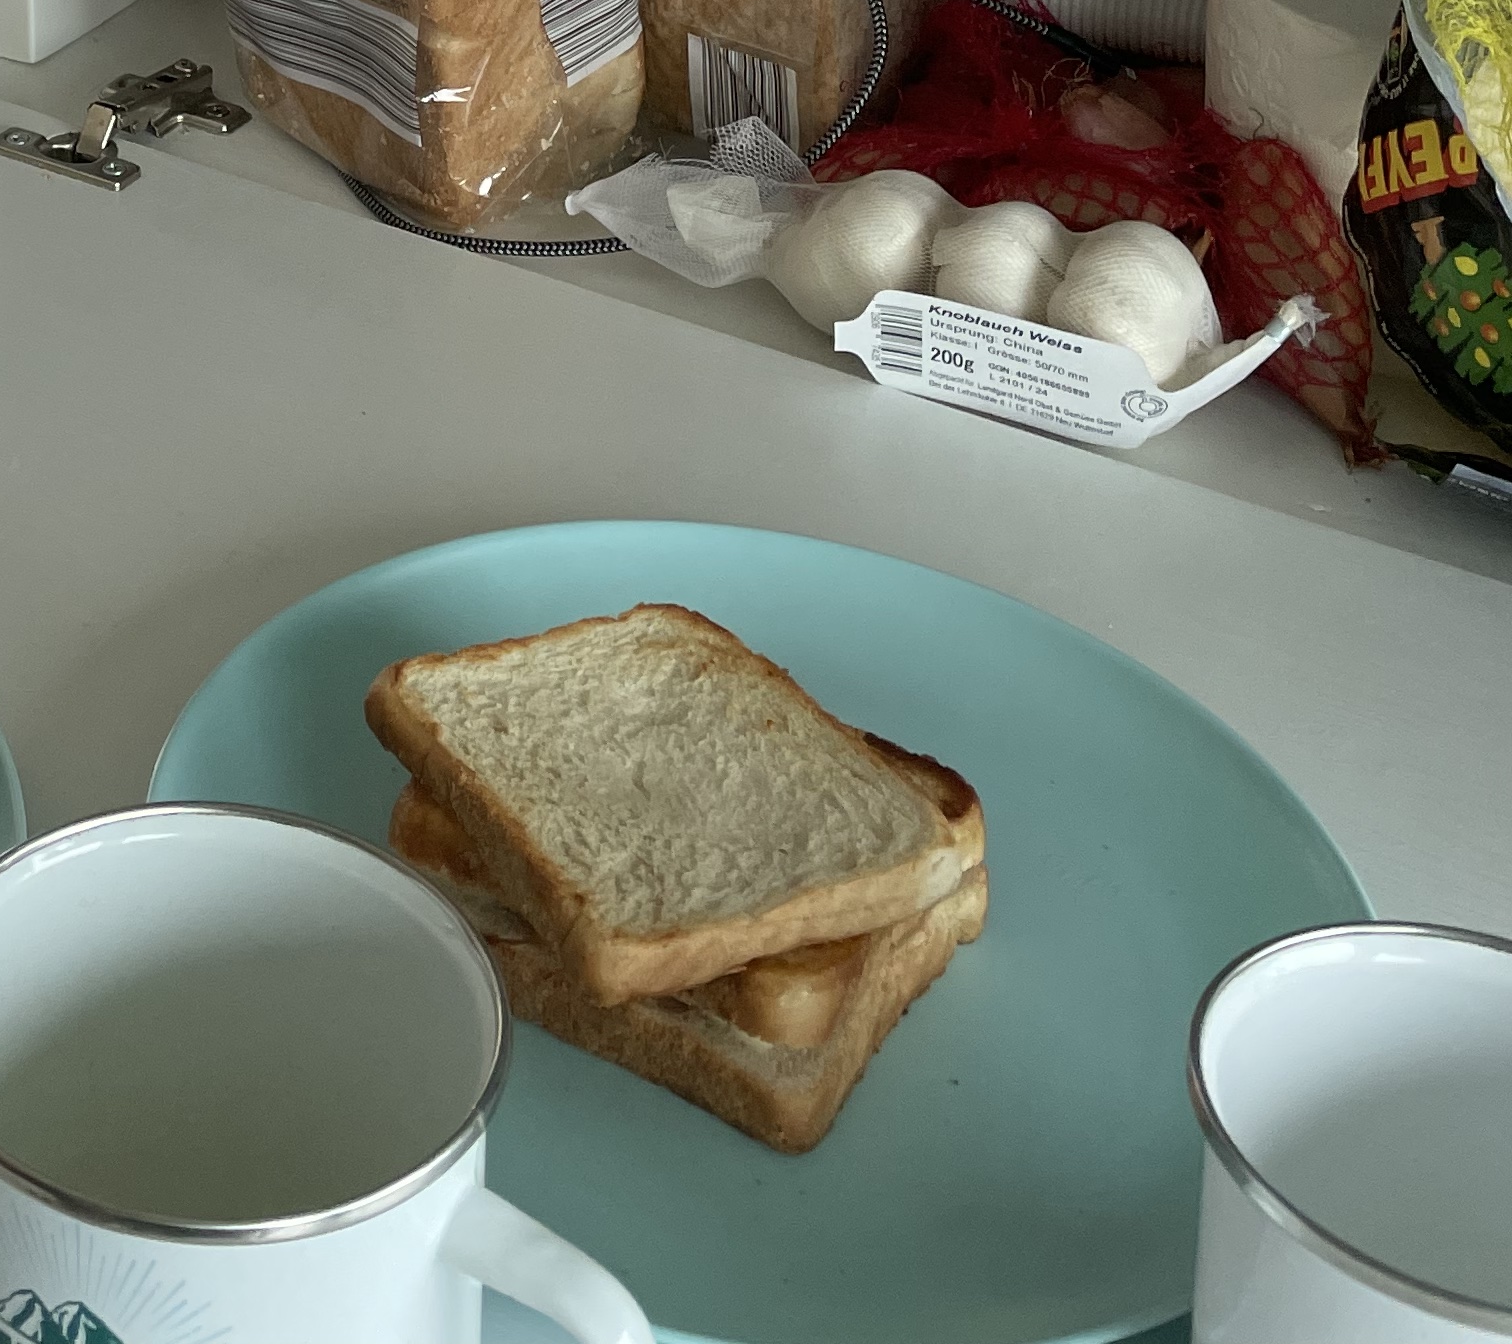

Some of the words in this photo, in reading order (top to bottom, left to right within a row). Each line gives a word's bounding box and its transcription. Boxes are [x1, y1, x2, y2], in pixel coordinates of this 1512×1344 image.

[928, 305, 1024, 337] Knoblauch
[1030, 330, 1083, 355] Weiss
[930, 319, 999, 344] Ursprung:
[1003, 336, 1044, 357] China
[930, 332, 973, 349] Klasse:
[1068, 371, 1089, 383] mm
[931, 348, 974, 373] 200g
[1036, 387, 1048, 396] 24
